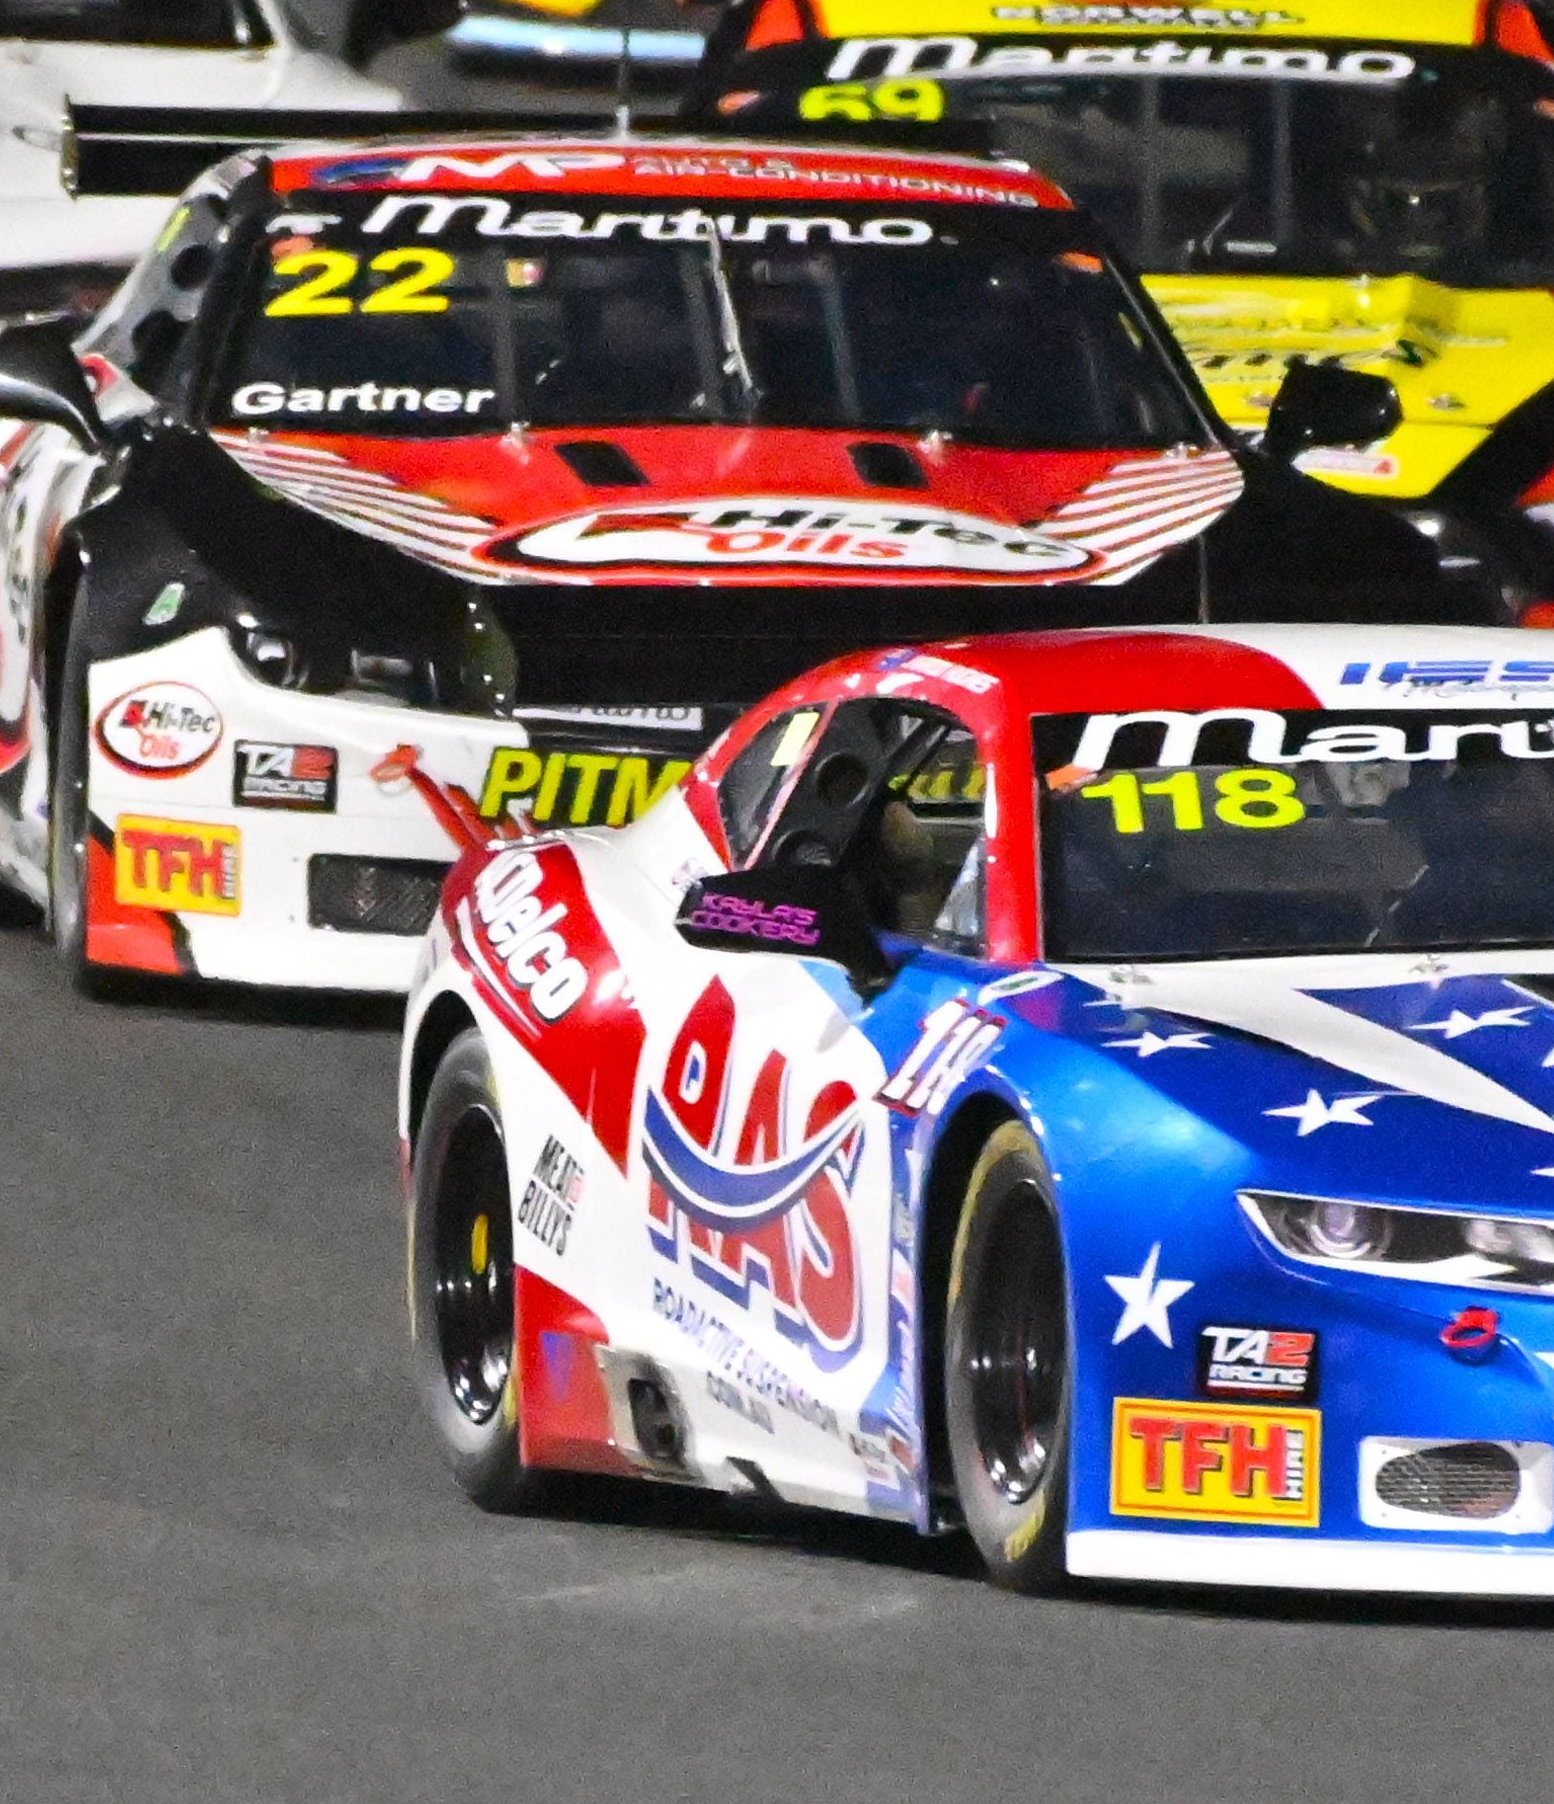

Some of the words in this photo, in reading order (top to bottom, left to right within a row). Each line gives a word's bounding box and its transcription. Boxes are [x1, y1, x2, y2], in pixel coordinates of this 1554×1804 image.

[263, 246, 456, 318] 22
[231, 380, 496, 419] Gartner
[706, 530, 908, 560] Oils
[708, 508, 1073, 557] Hi-Tec
[144, 700, 217, 735] Hi-Tec
[140, 734, 182, 760] Oils
[1082, 769, 1306, 834] 118
[121, 830, 226, 898] TFH
[1201, 1325, 1316, 1367] TA2
[1128, 1416, 1288, 1498] TFH
